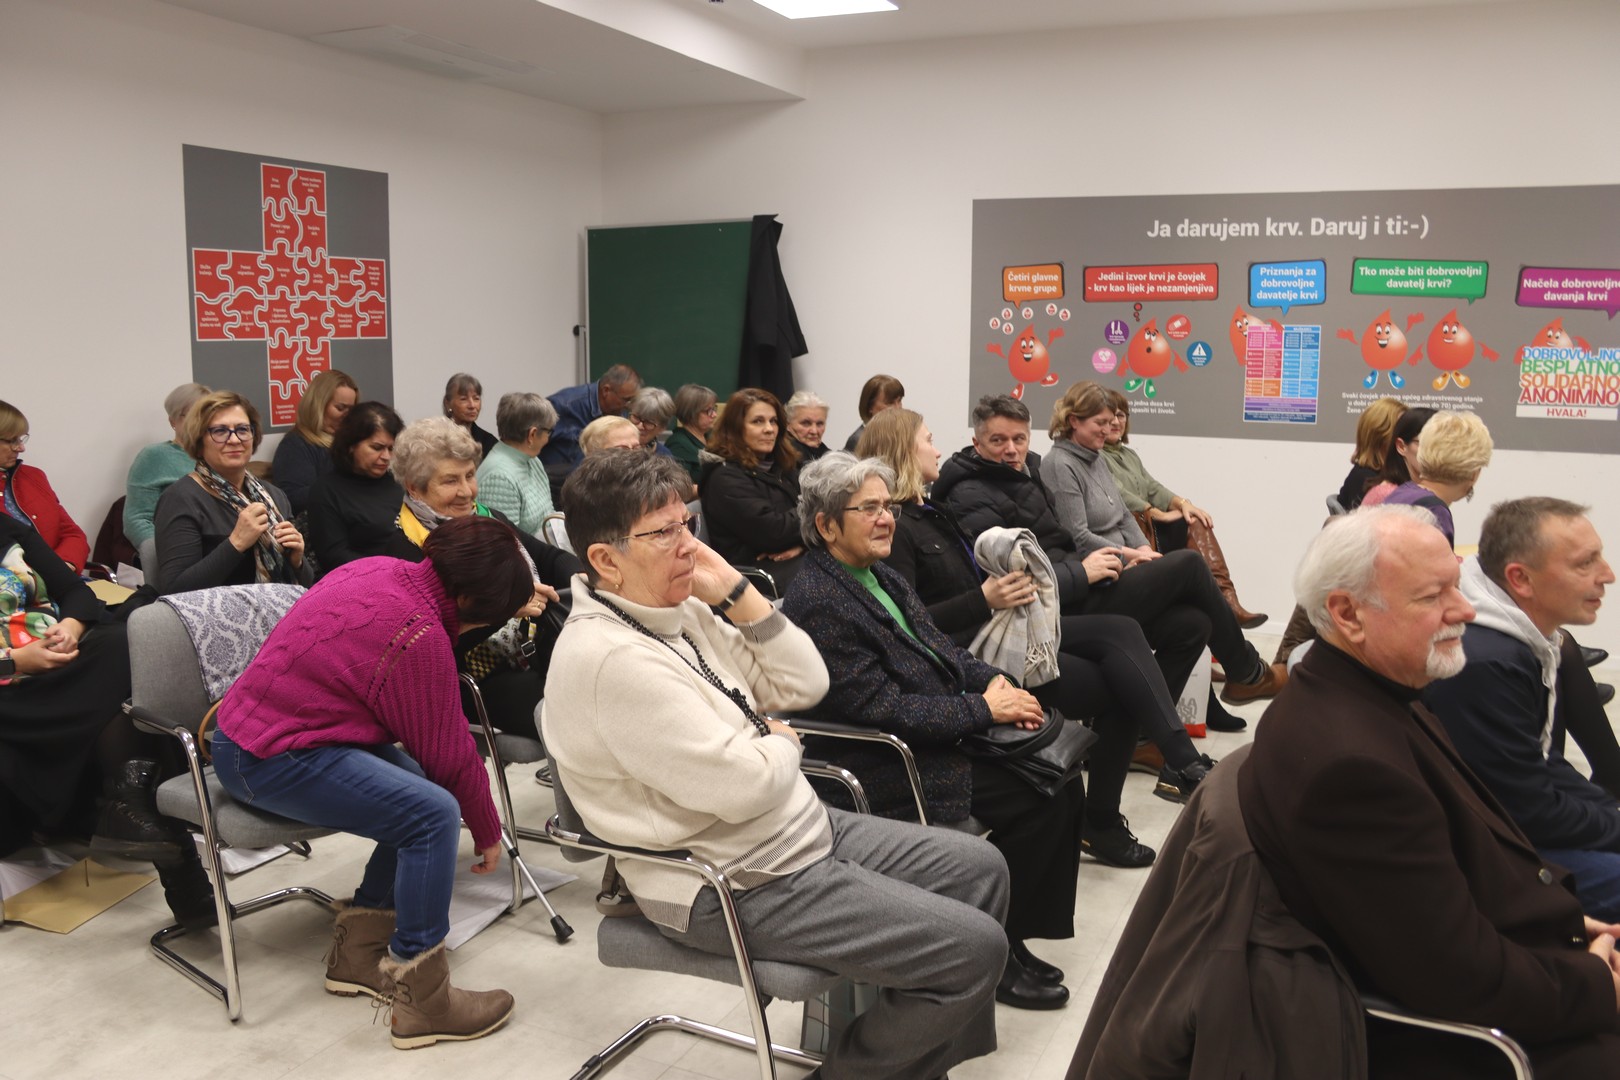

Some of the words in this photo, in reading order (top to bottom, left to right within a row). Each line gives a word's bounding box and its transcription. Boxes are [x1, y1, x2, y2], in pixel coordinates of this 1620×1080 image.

[1147, 220, 1171, 238] Ja
[1176, 218, 1260, 241] darujem
[1265, 217, 1303, 236] krv.
[1310, 216, 1367, 240] Daruj
[1373, 216, 1380, 235] i
[1008, 271, 1030, 281] Četiri
[1031, 272, 1058, 283] glavne
[1098, 272, 1124, 281] Jedini
[1126, 272, 1147, 281] izvor
[1149, 272, 1165, 281] krvi
[1167, 272, 1176, 283] je
[1178, 271, 1206, 283] čovjek
[1260, 267, 1303, 278] Priznanja
[1306, 268, 1317, 276] za
[1359, 266, 1377, 276] Tko
[1379, 266, 1405, 276] može
[1408, 266, 1424, 276] biti
[1426, 266, 1482, 277] dobrovoljni
[1094, 284, 1108, 292] krv
[1109, 284, 1125, 292] kao
[1127, 283, 1145, 294] lijek
[1146, 283, 1155, 294] je
[1157, 283, 1214, 294] nezamjenjiva
[1261, 278, 1315, 289] dobrovoljne
[1386, 279, 1424, 290] davatelj
[1427, 279, 1452, 288] krvi?
[1523, 278, 1559, 288] Načela
[1009, 284, 1031, 292] krvne
[1033, 285, 1057, 294] grupe
[1256, 290, 1298, 302] davatelje
[1300, 290, 1318, 300] krvi
[1543, 291, 1584, 303] davanja
[1587, 291, 1608, 301] krvi
[1521, 359, 1620, 375] BESPLATNO
[1520, 372, 1620, 389] SOLIDARNO
[1520, 388, 1620, 405] ANONIMNO
[1546, 408, 1587, 417] HVALA!
